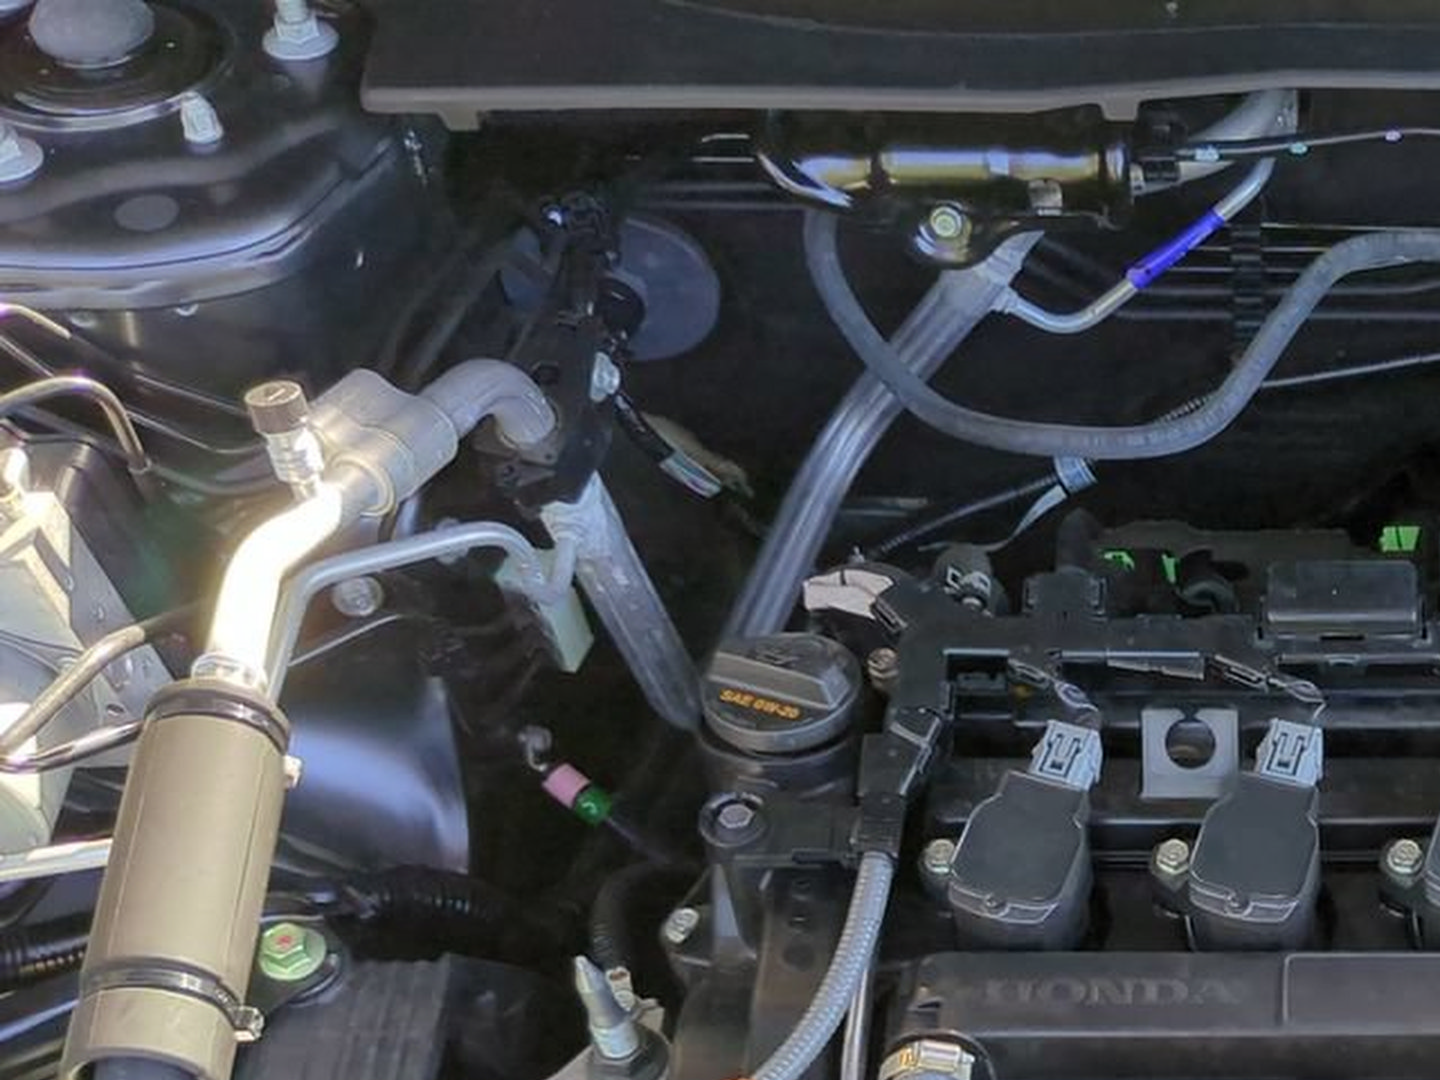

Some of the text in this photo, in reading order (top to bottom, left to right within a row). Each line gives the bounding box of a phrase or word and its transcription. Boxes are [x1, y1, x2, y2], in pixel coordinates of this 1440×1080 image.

[720, 689, 800, 719] SAE 0W-20
[984, 976, 1243, 1006] HONDA
